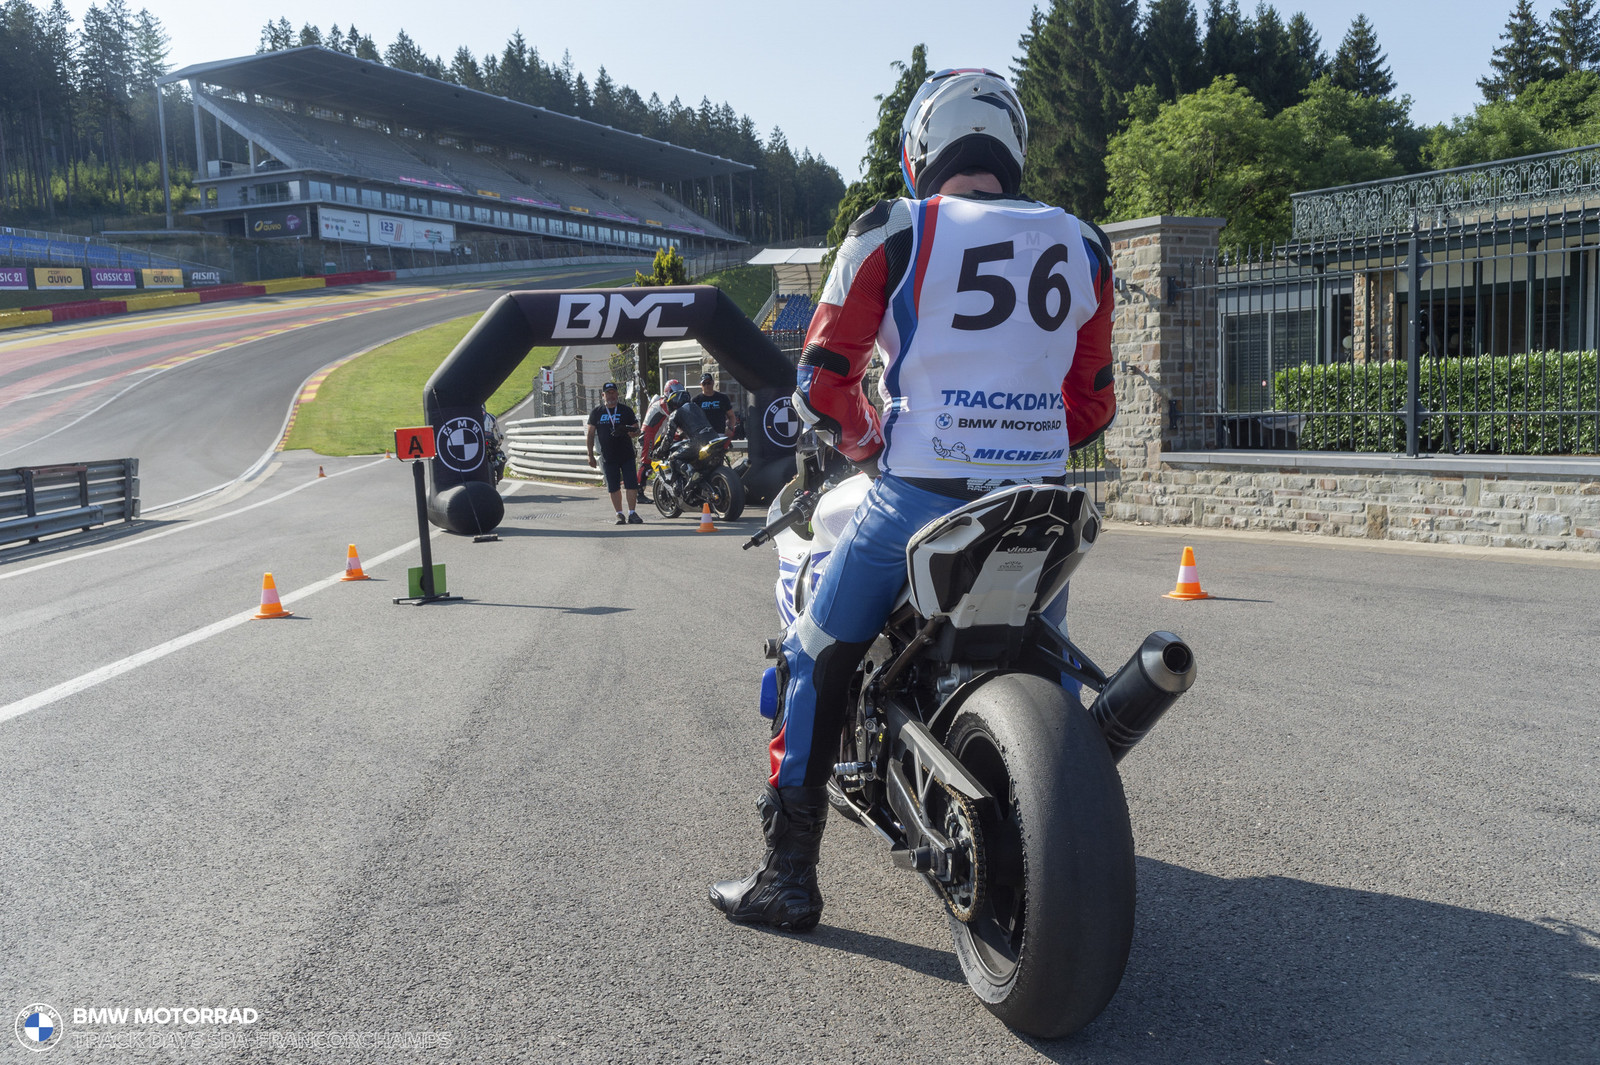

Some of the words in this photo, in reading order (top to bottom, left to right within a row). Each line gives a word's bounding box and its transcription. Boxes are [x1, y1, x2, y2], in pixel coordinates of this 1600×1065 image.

[381, 221, 394, 232] 123
[13, 272, 23, 282] 21
[95, 272, 123, 282] CLASSIC
[123, 272, 132, 282] 21
[192, 271, 215, 280] AISIN
[951, 240, 1072, 332] 56
[551, 292, 695, 339] BMC
[941, 389, 1064, 411] TRACKDAYS
[442, 420, 480, 437] BMW
[958, 418, 998, 429] BMW
[1000, 419, 1062, 432] MOTORRAD
[408, 435, 424, 455] A
[973, 448, 1065, 461] MICHELIN
